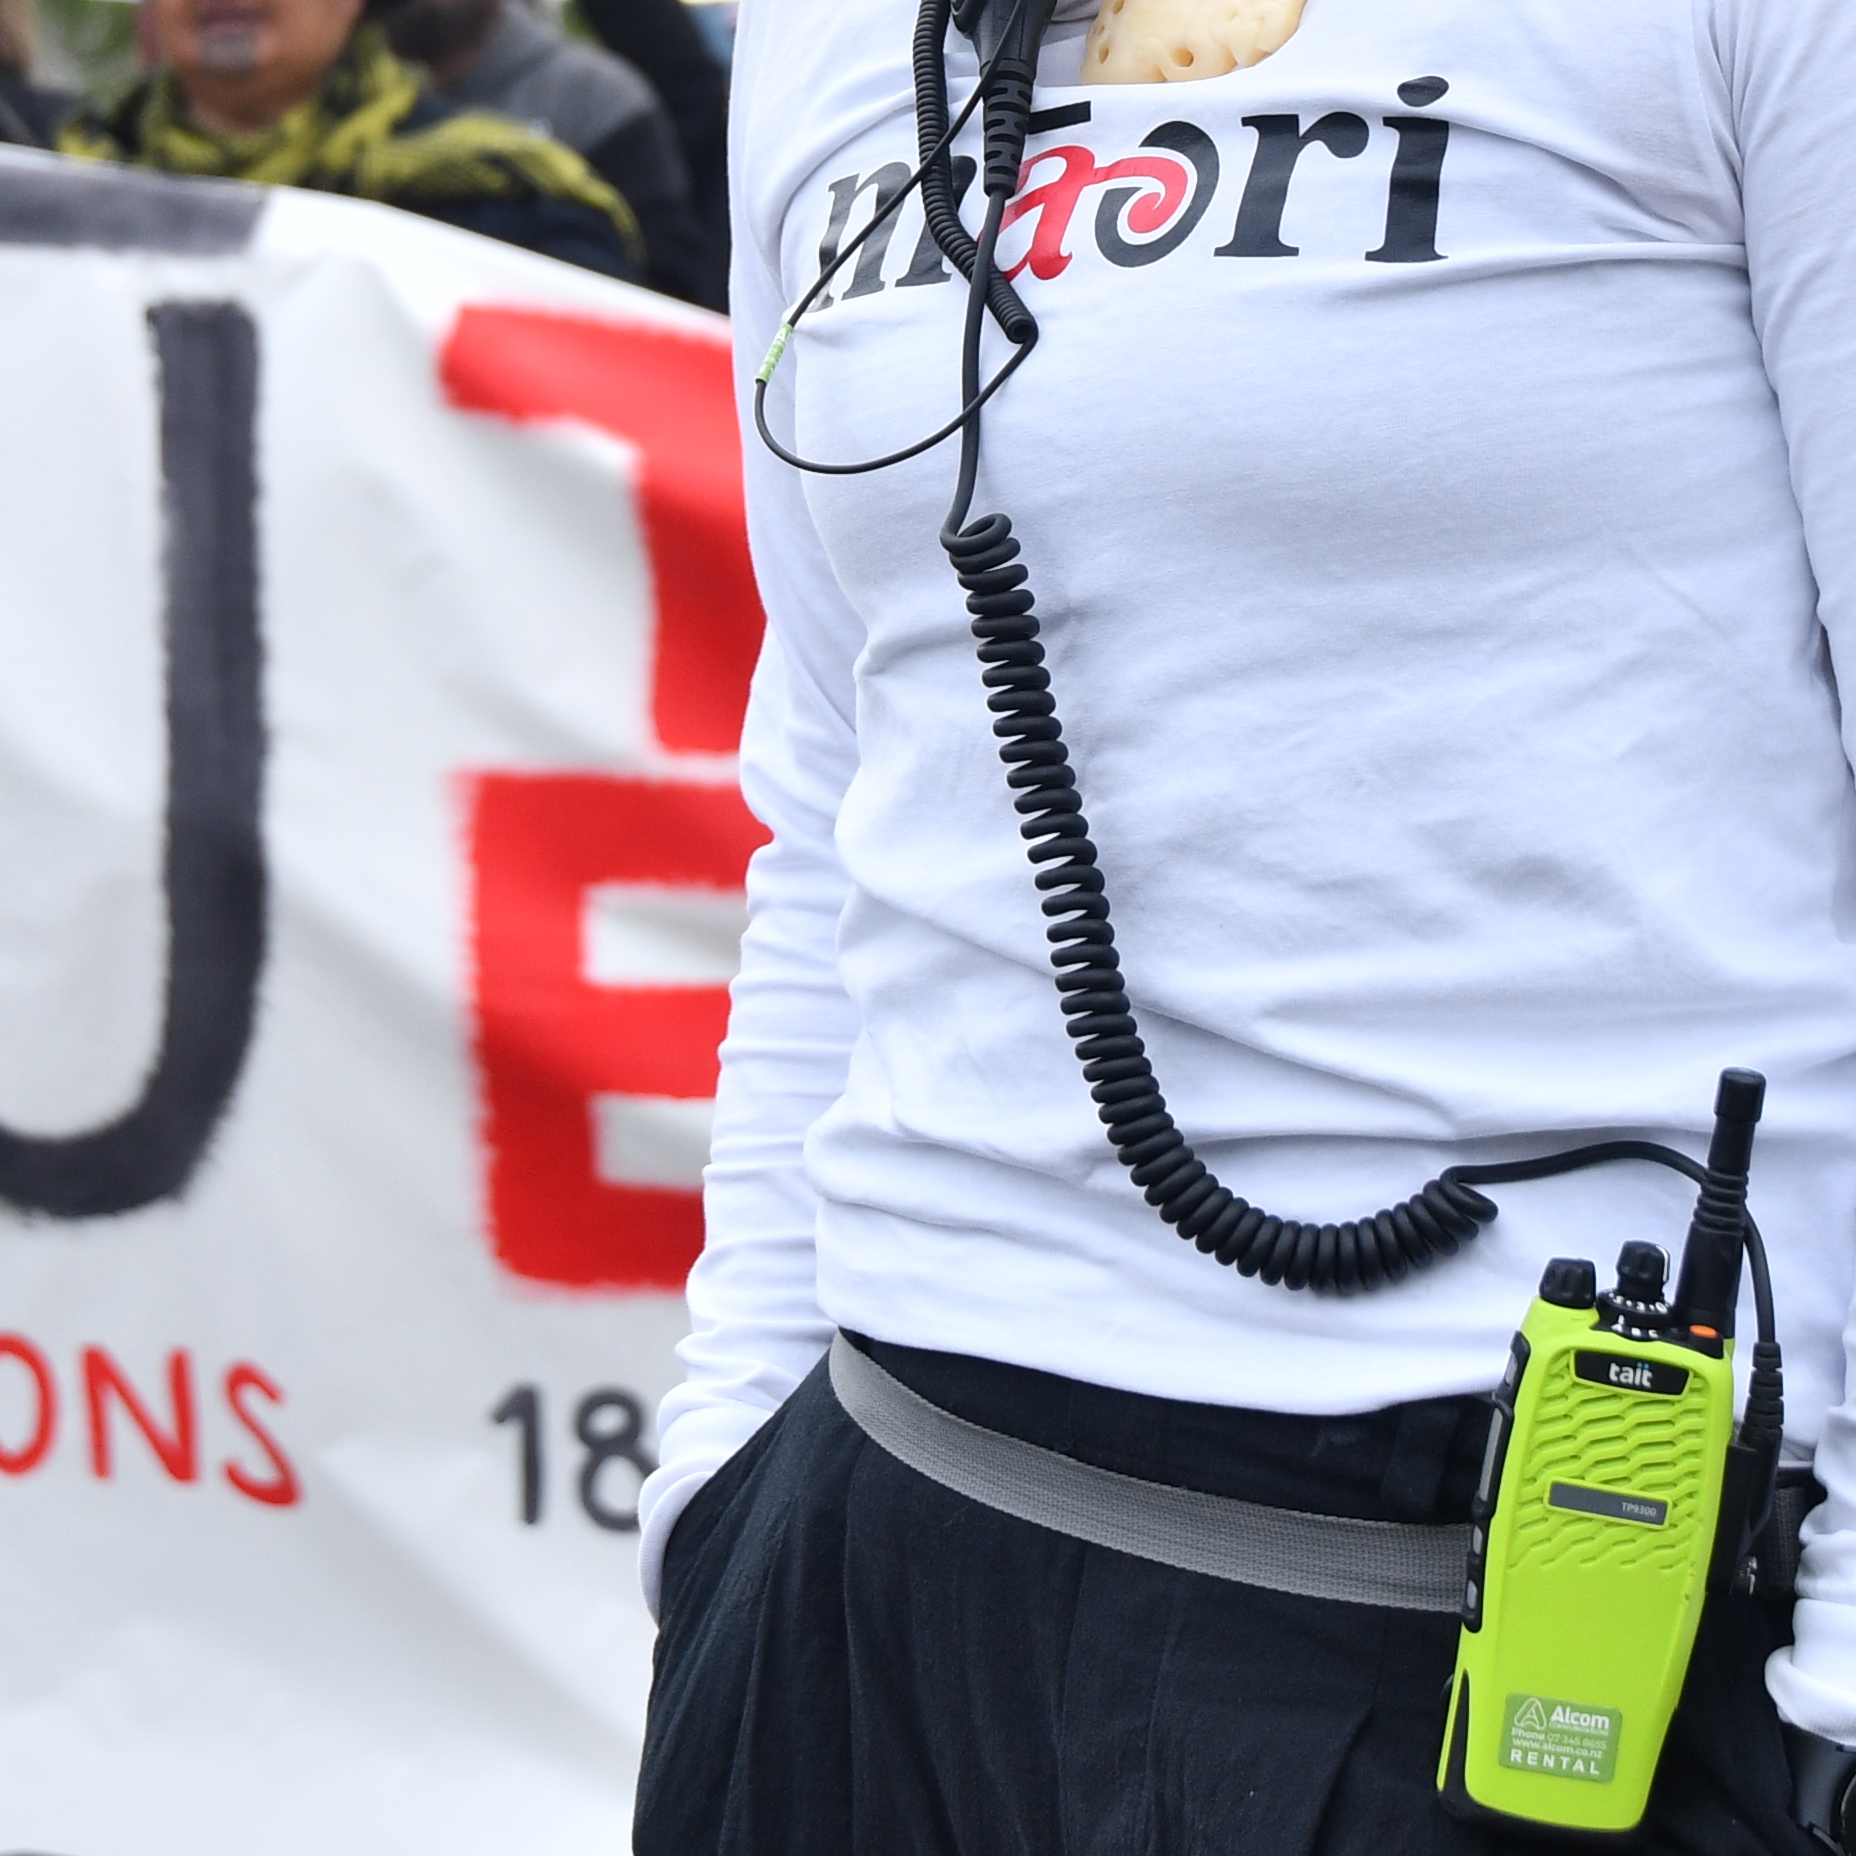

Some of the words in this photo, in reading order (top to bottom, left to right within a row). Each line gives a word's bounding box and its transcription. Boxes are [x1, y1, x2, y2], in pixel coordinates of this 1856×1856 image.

[1621, 1501, 1657, 1517] TP9300
[1550, 1705, 1610, 1729] Alcom
[1511, 1726, 1545, 1741] Phone
[1512, 1736, 1604, 1759] www.alcom.co.nz
[1509, 1748, 1601, 1776] RENTAL
